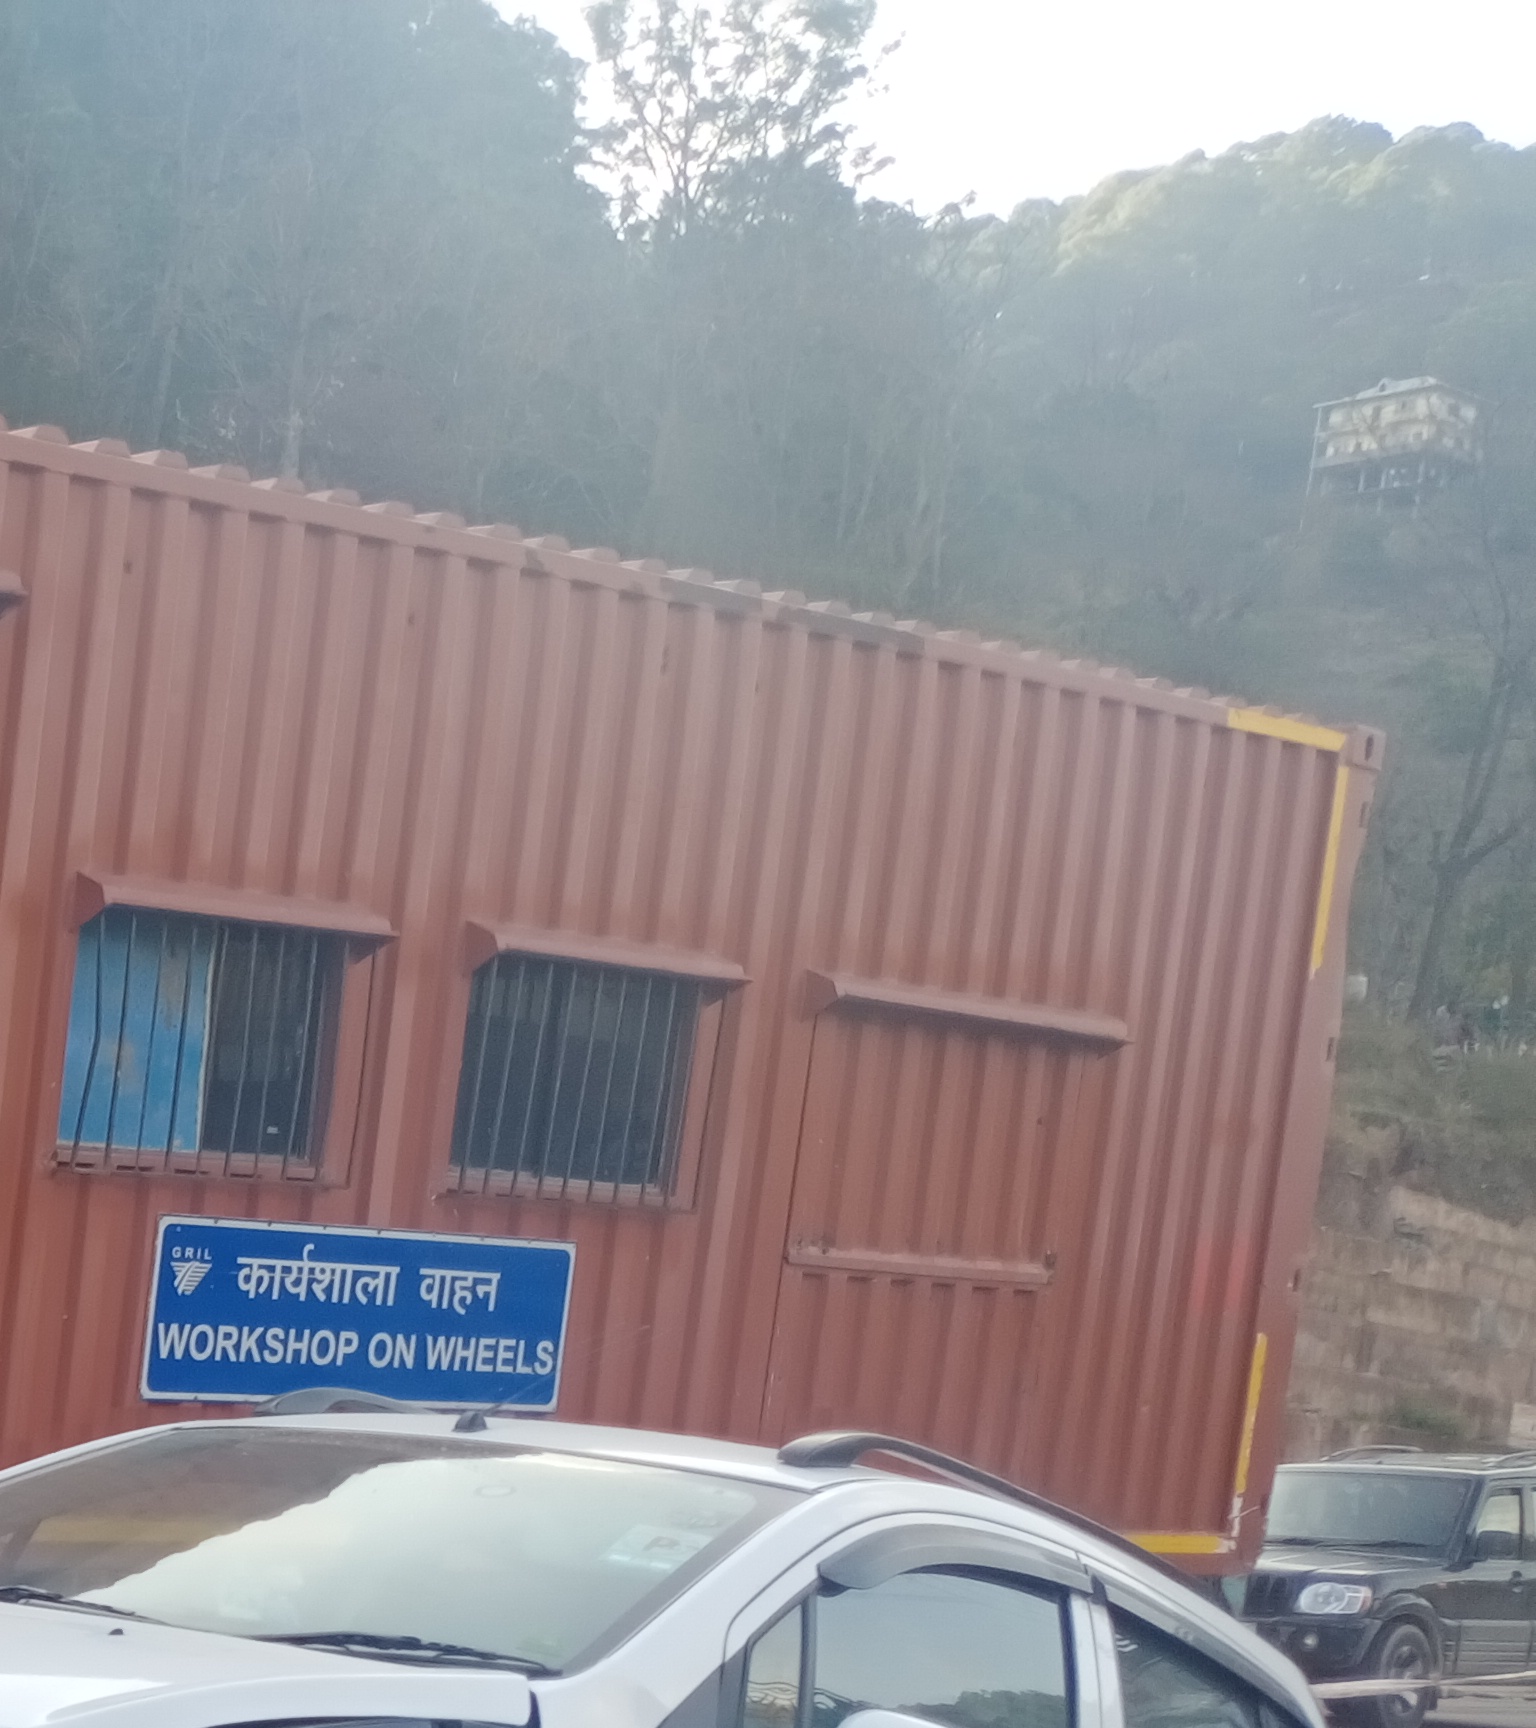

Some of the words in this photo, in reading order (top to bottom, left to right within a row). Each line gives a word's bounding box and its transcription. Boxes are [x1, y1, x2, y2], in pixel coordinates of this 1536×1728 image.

[171, 1246, 213, 1261] GRIL
[236, 1243, 400, 1306] कार्यशाला
[419, 1267, 501, 1315] वाहन
[157, 1322, 359, 1367] WORKSHOP
[368, 1333, 416, 1369] ON
[426, 1334, 555, 1375] WHEELS
